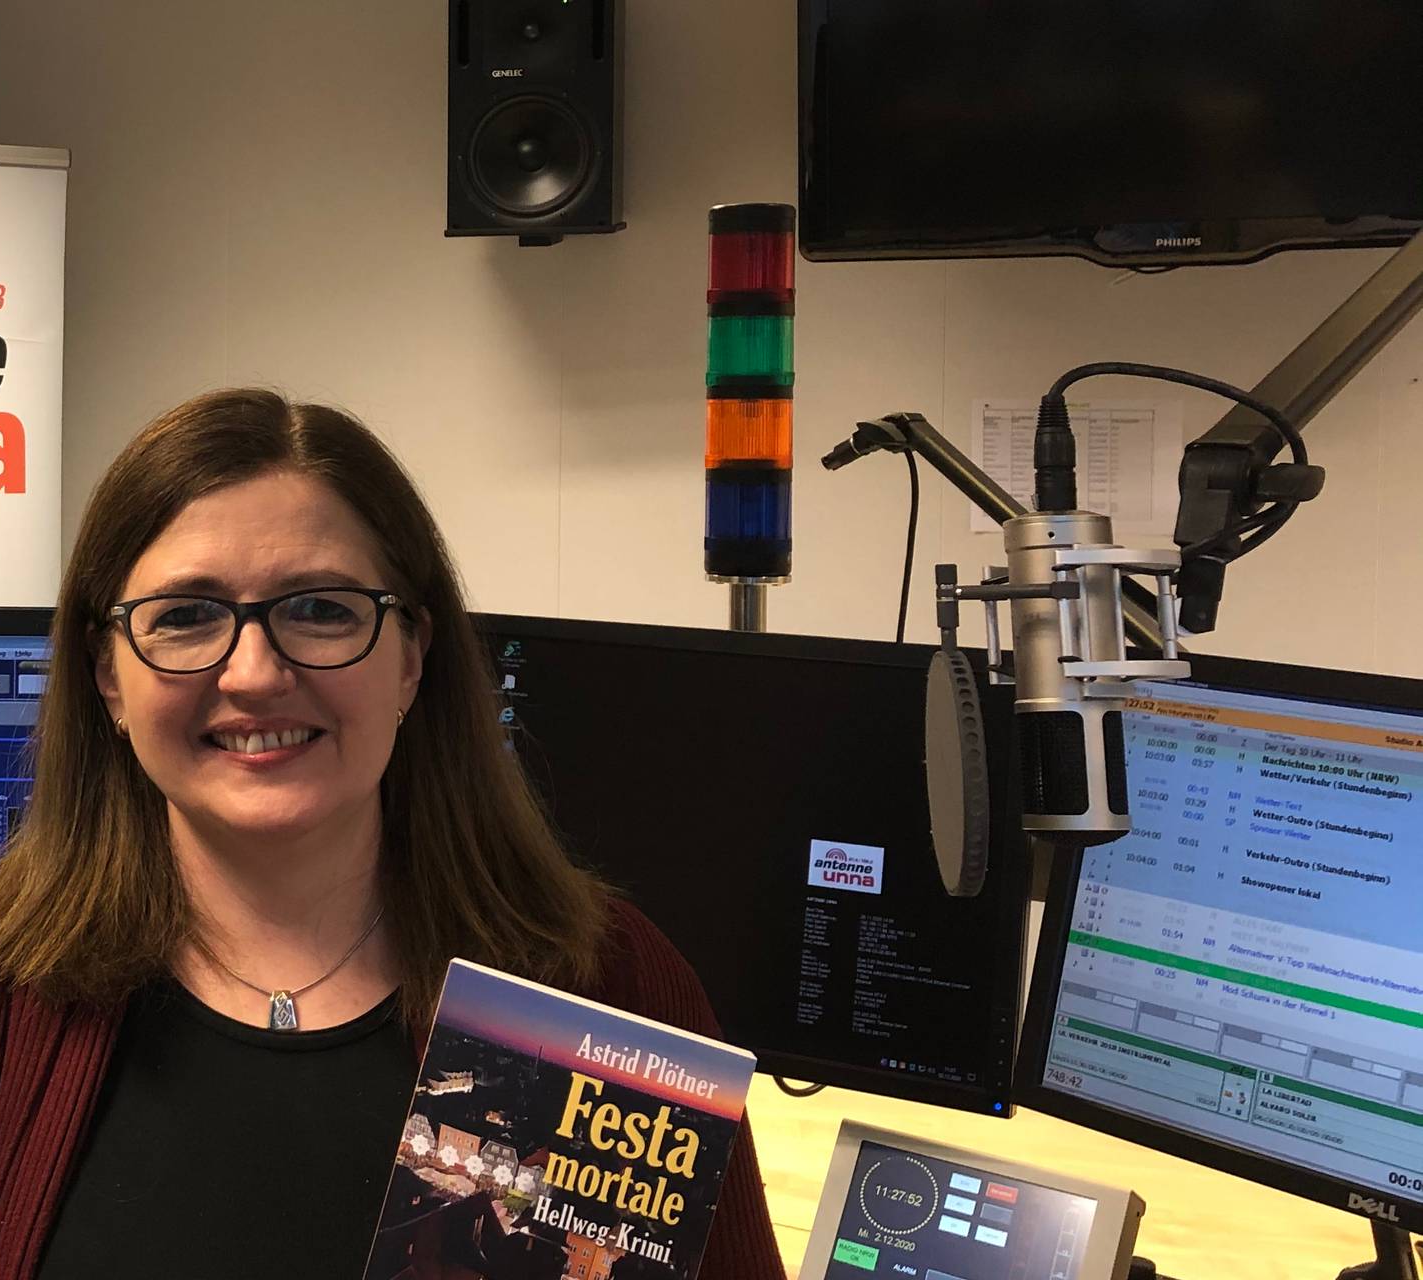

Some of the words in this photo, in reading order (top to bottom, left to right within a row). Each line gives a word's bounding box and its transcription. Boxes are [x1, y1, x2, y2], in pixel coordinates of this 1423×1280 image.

[491, 69, 523, 77] GENELEC
[1155, 237, 1203, 247] PHILIPS
[14, 650, 32, 658] Help
[1385, 736, 1412, 746] Studio
[1262, 755, 1317, 772] Nachrichten
[1347, 767, 1364, 779] Uhr
[1260, 768, 1332, 788] Wetter/Verkehr
[1334, 778, 1413, 802] (Stundenbeginn)
[1253, 808, 1314, 832] Wetter-Outro
[1315, 819, 1394, 843] (Stundenbeginn)
[814, 858, 873, 875] antenne
[1246, 849, 1310, 871] Verkehr-Outro
[1311, 860, 1392, 886] (Stundenbeginn)
[823, 872, 875, 888] unna
[1241, 875, 1297, 895] Showopener
[1298, 887, 1321, 900] lokal
[576, 1033, 639, 1076] Astrid
[643, 1051, 719, 1100] Plötner
[1047, 1068, 1083, 1088] 748:42
[555, 1071, 701, 1179] Festa
[542, 1150, 685, 1227] mortale
[875, 1185, 924, 1208] 11:27:52
[1348, 1192, 1401, 1222] DELL
[533, 1195, 674, 1265] Hellweg-Krimi
[893, 1263, 918, 1276] ALARM
